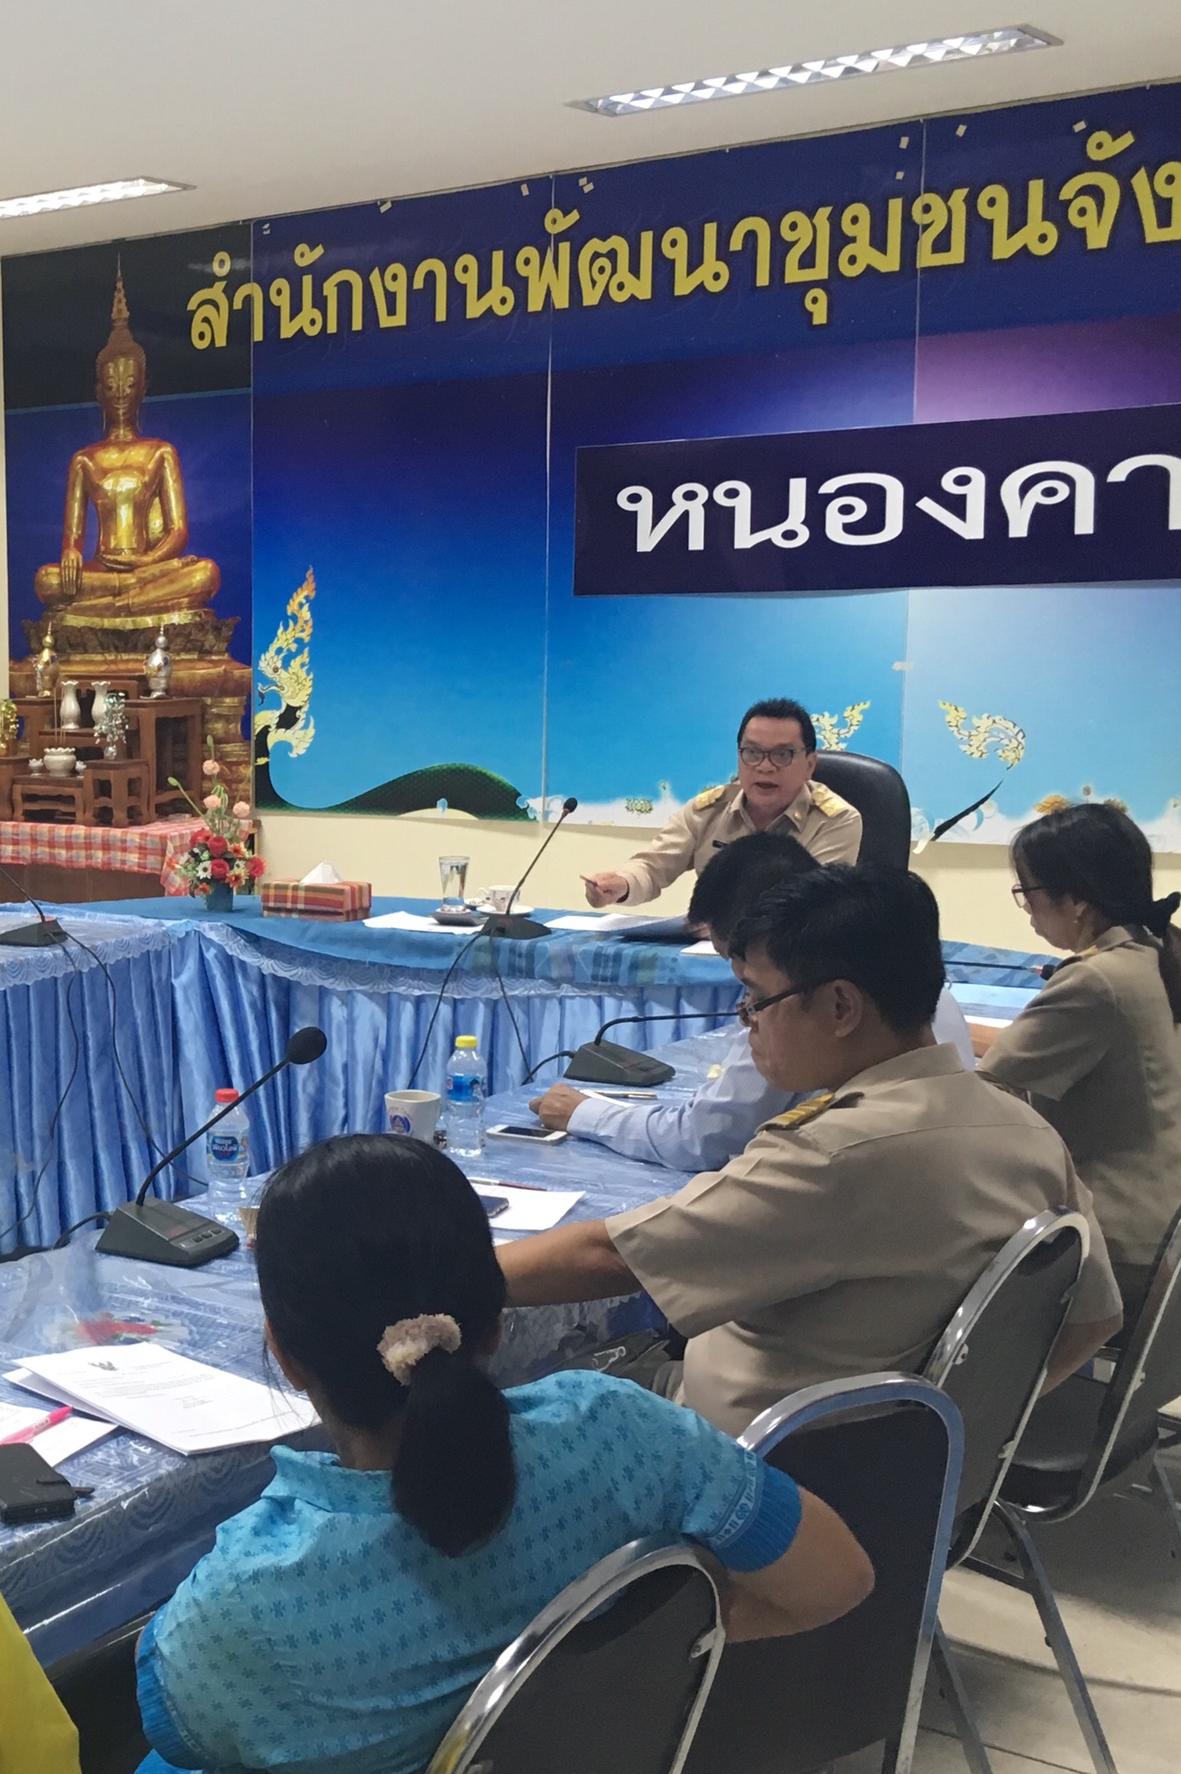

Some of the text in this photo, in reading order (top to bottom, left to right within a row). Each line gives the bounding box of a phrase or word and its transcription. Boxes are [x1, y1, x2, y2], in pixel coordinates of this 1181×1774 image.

[186, 130, 1181, 350] สำนักงานพัฒนาชุมชนจัง
[617, 453, 1181, 555] หนองคา
